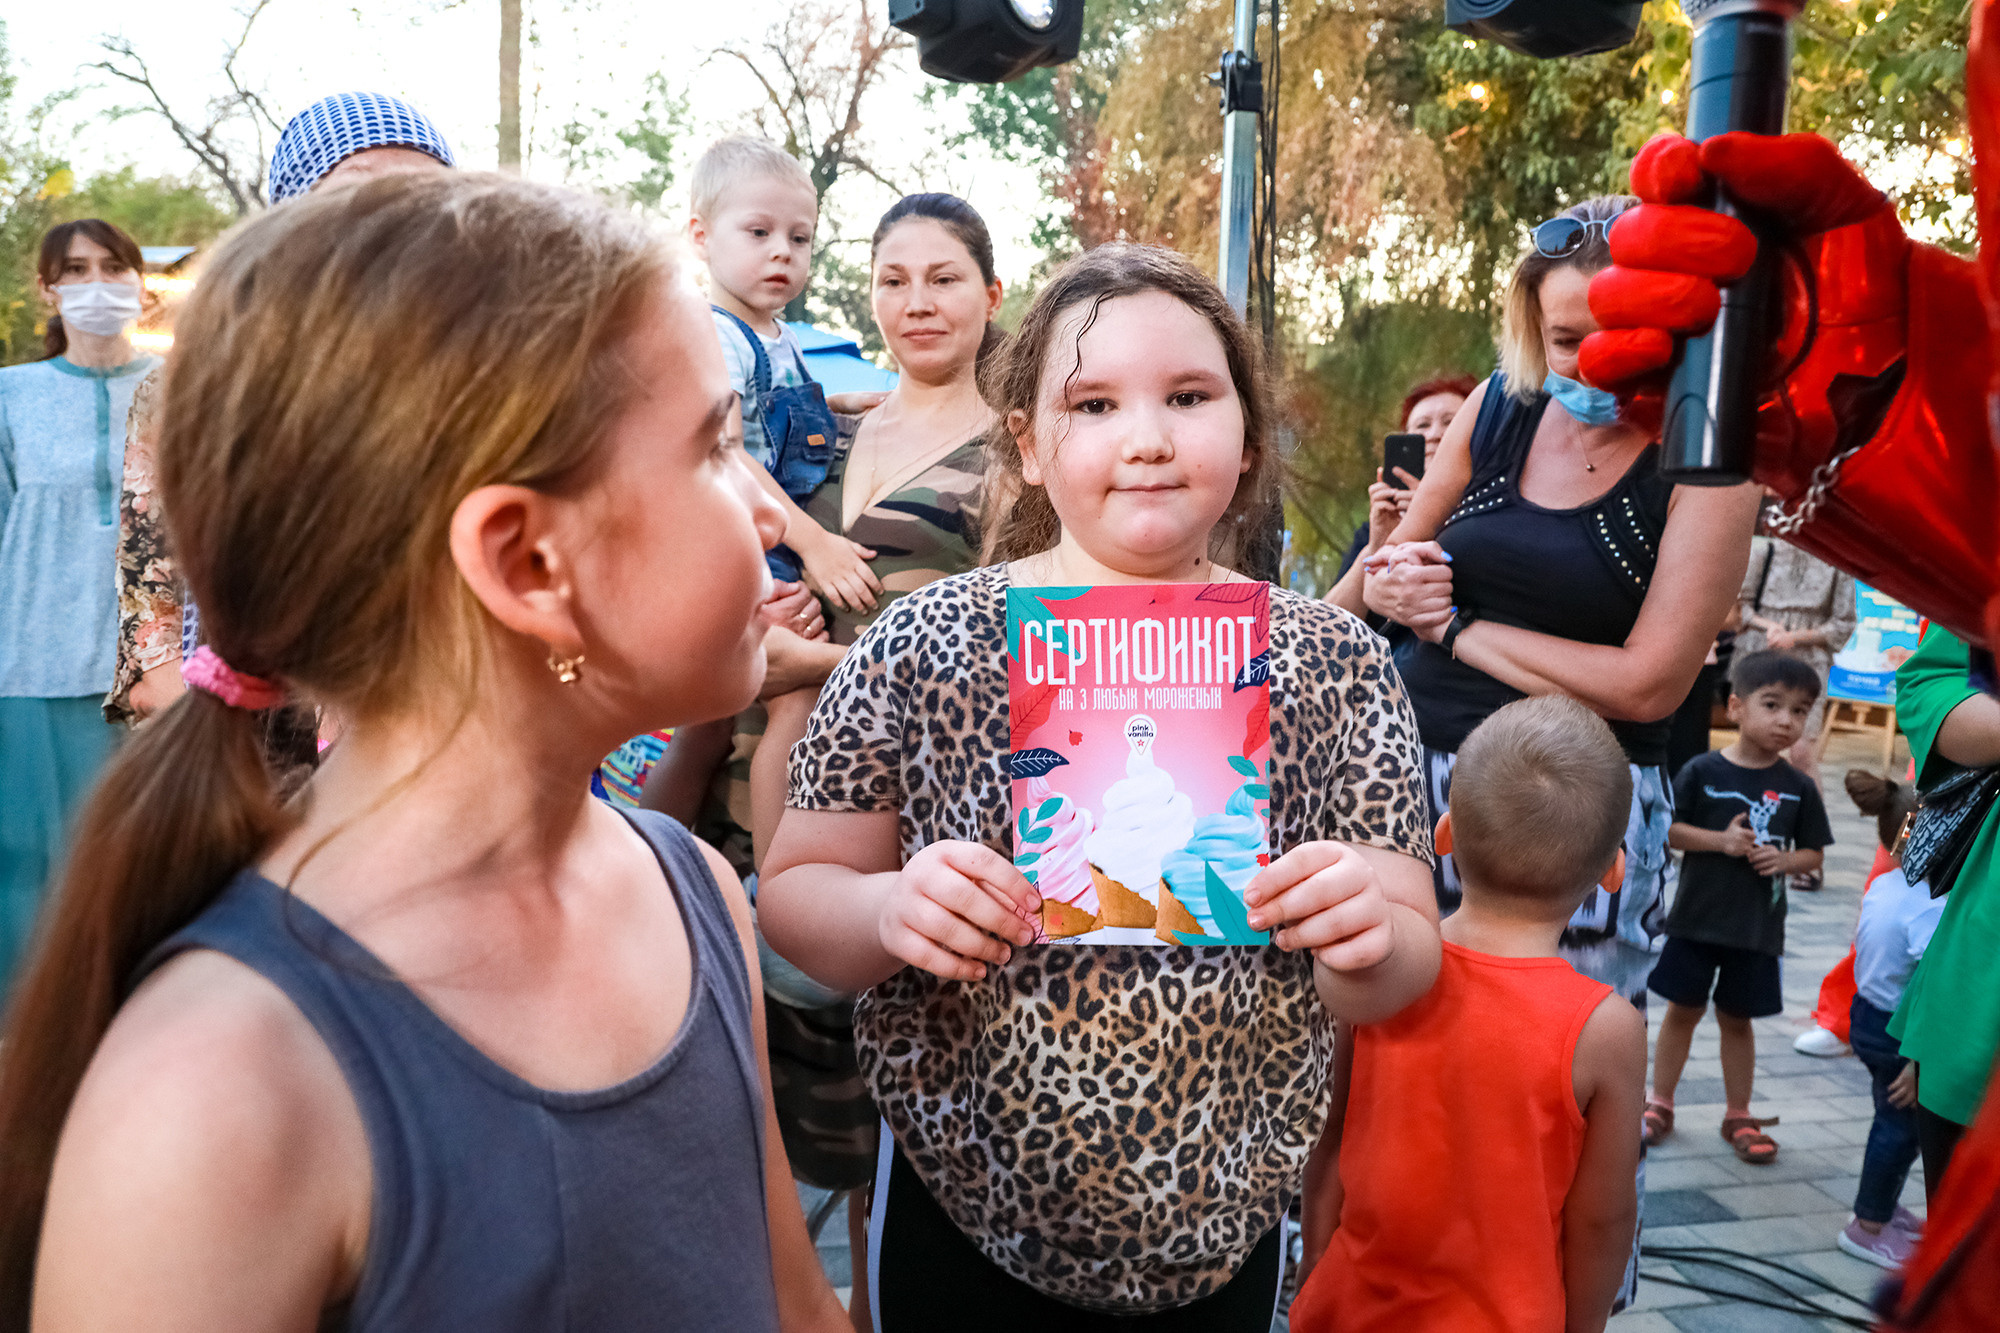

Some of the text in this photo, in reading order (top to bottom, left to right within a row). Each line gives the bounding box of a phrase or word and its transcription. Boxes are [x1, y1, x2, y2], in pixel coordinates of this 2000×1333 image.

[1024, 616, 1256, 685] СЕРТИФИКАТ
[1059, 687, 1222, 710] НА 3 ЛЮБЫХ МОРОЖЕНЫХ
[1132, 724, 1149, 732] pink
